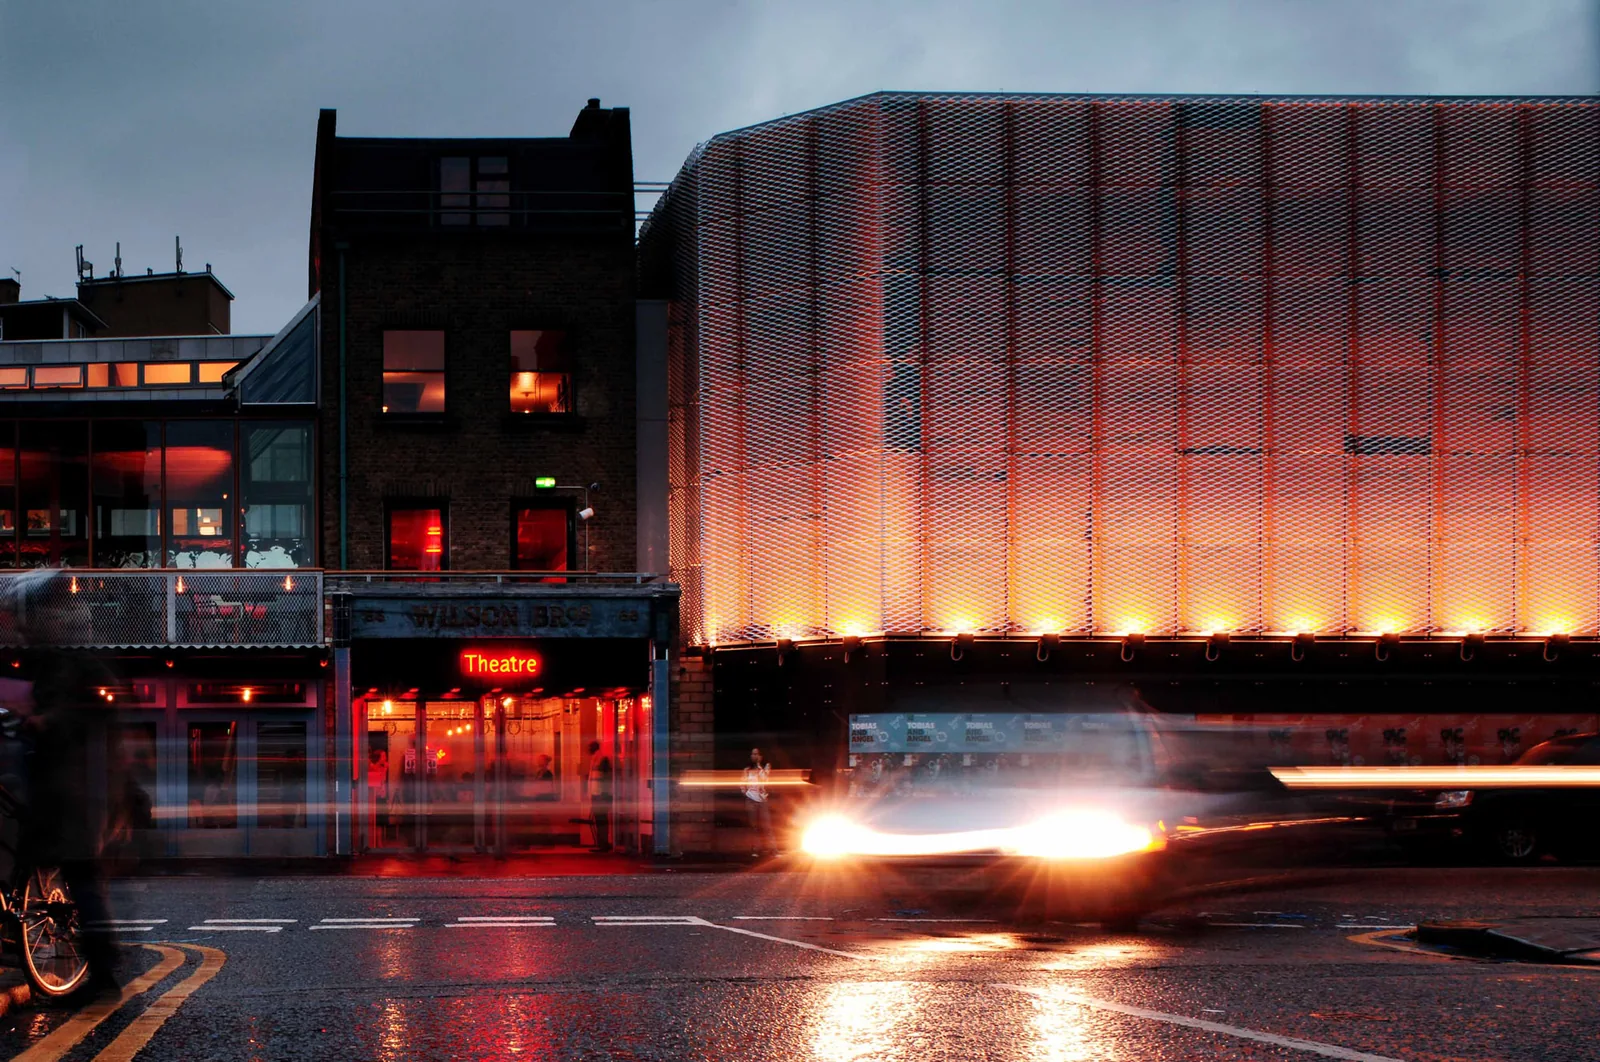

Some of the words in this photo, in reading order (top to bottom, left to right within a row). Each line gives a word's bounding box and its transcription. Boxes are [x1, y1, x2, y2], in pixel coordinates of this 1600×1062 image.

[411, 604, 518, 628] WILSON
[464, 654, 537, 672] Theatre
[851, 722, 877, 730] TOBIAS
[906, 721, 936, 729] TOBIAS
[965, 721, 993, 729] TOBIAS
[851, 735, 875, 743] ANGEL
